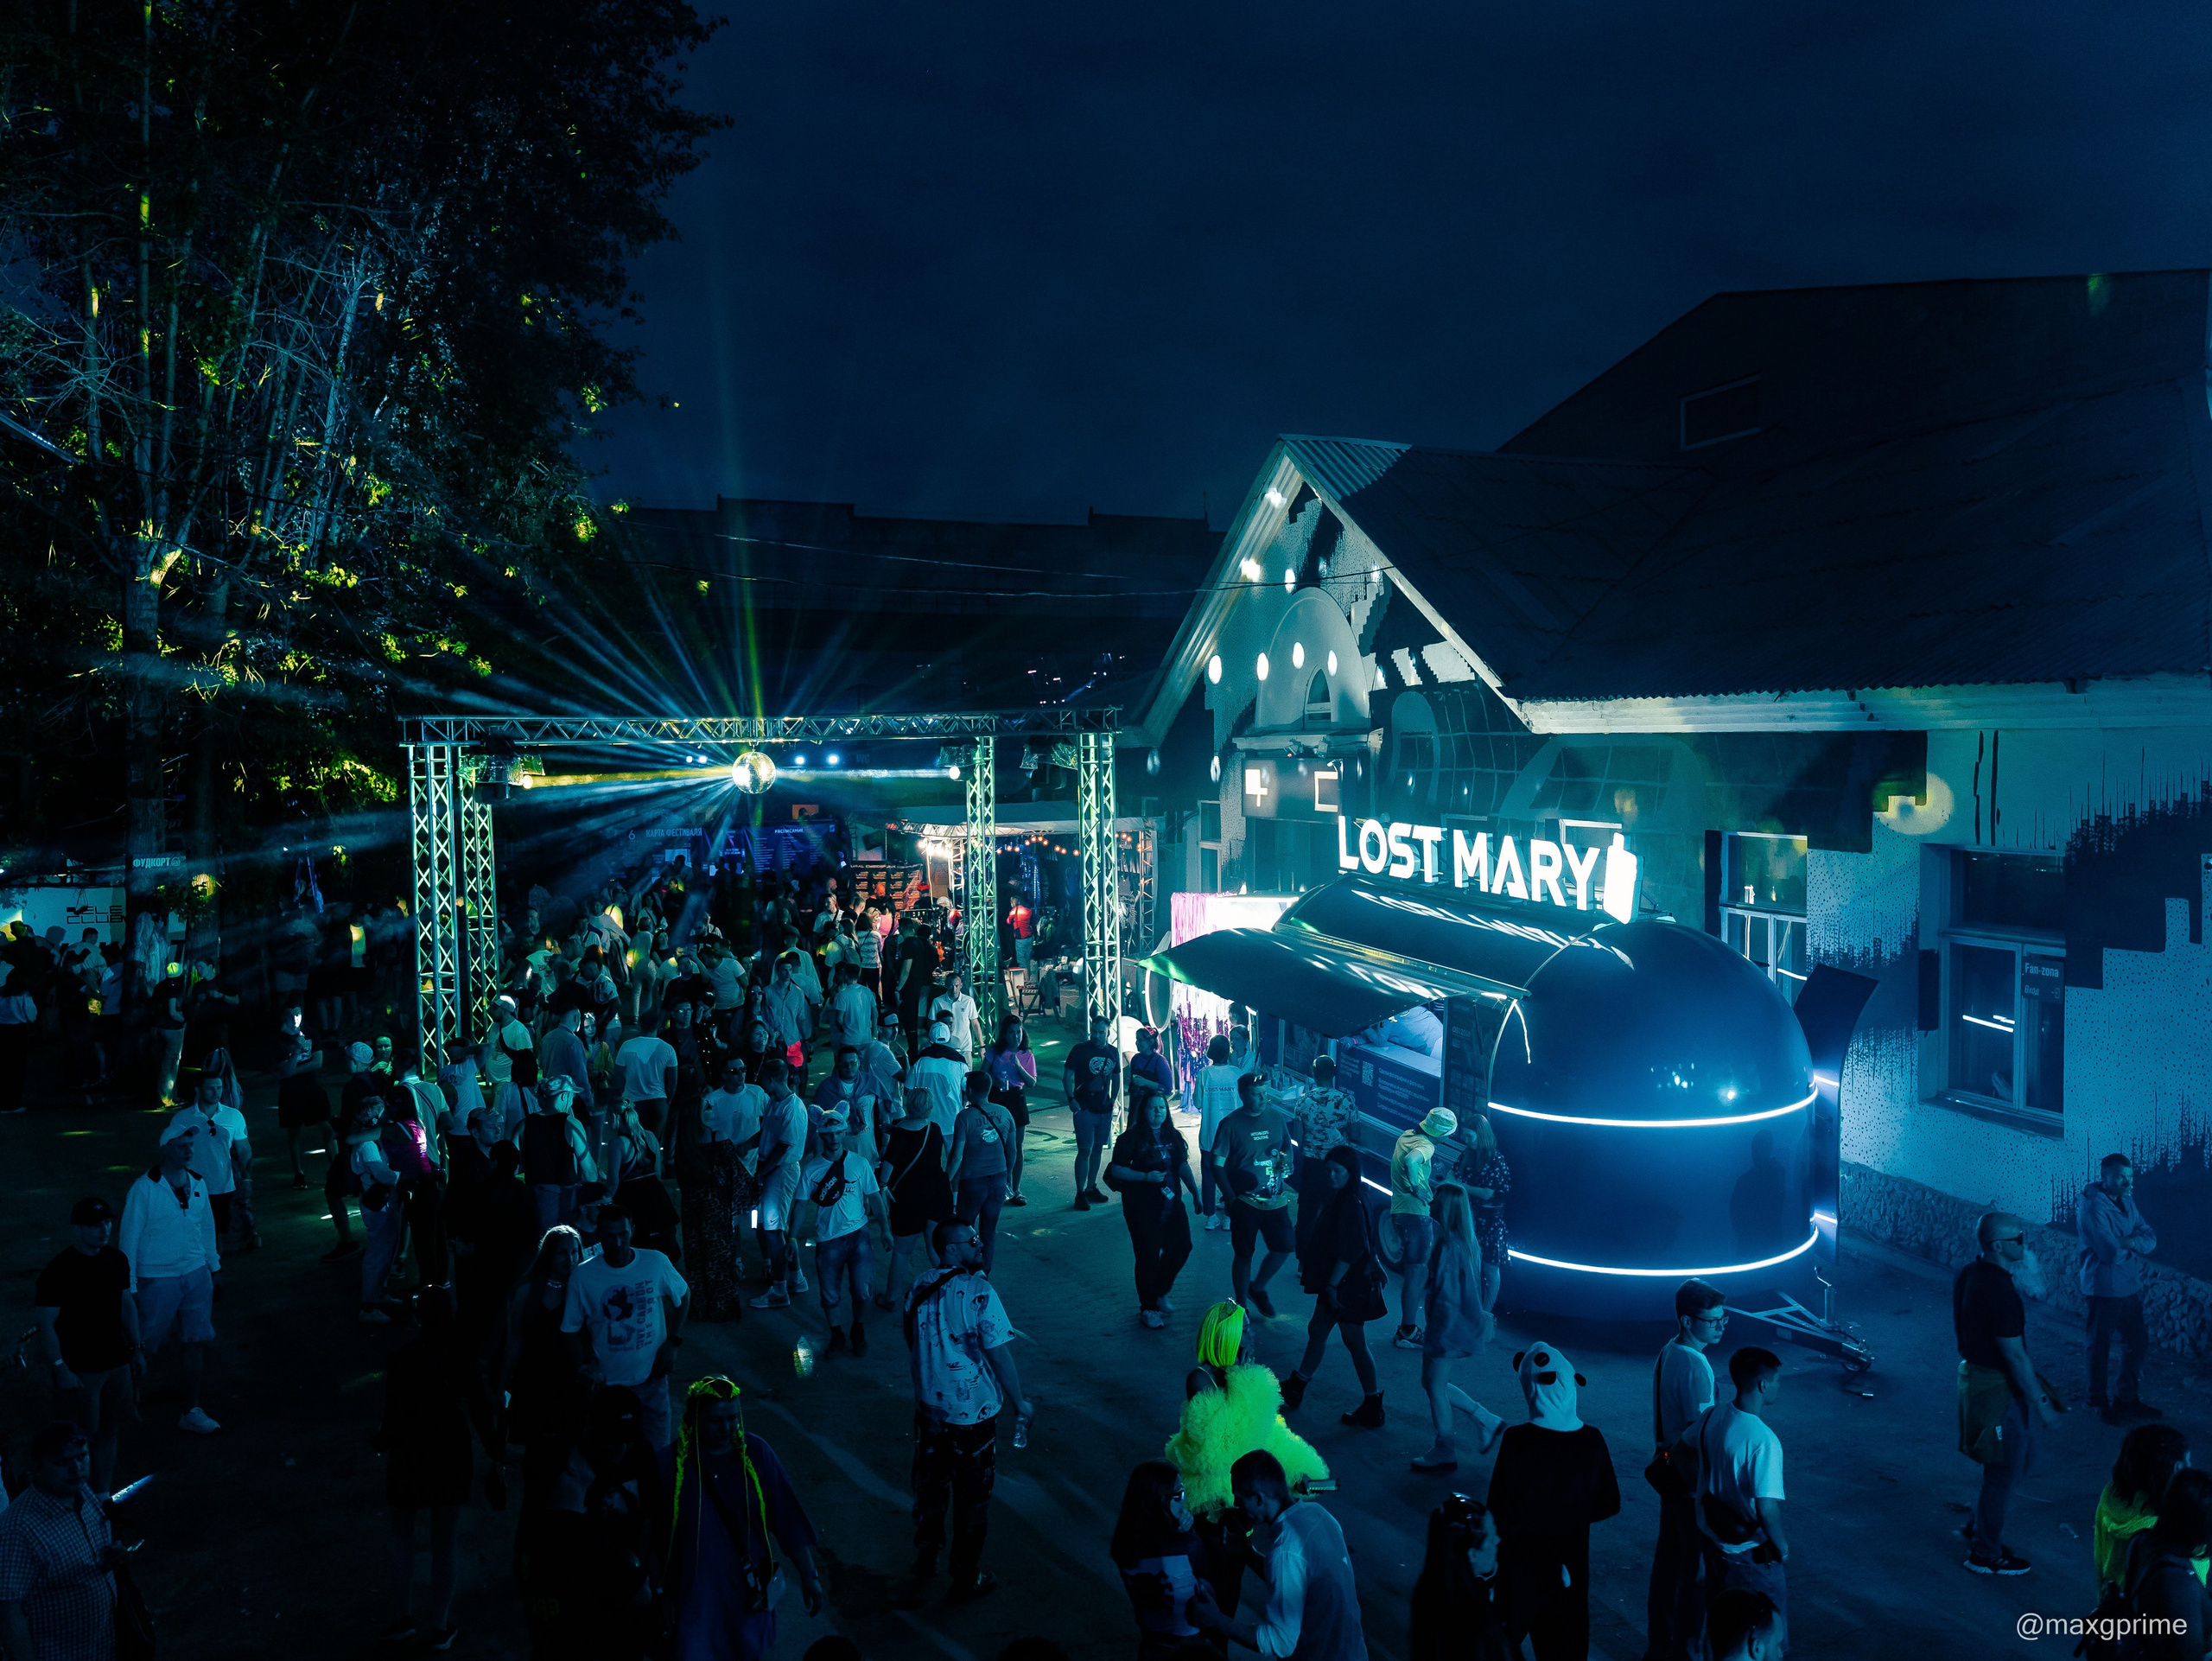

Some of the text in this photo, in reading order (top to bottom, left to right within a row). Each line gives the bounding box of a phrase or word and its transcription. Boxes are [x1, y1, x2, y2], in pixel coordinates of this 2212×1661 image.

[645, 827, 702, 837] КАРТА ФЕСТИВАЛЯ
[133, 857, 170, 869] ФУДКОРТ
[1338, 815, 1600, 911] LOST MARY
[67, 914, 124, 924] CLUB
[2024, 962, 2059, 978] Fan-zona
[2024, 984, 2040, 996] Вход
[819, 1176, 838, 1201] adidas
